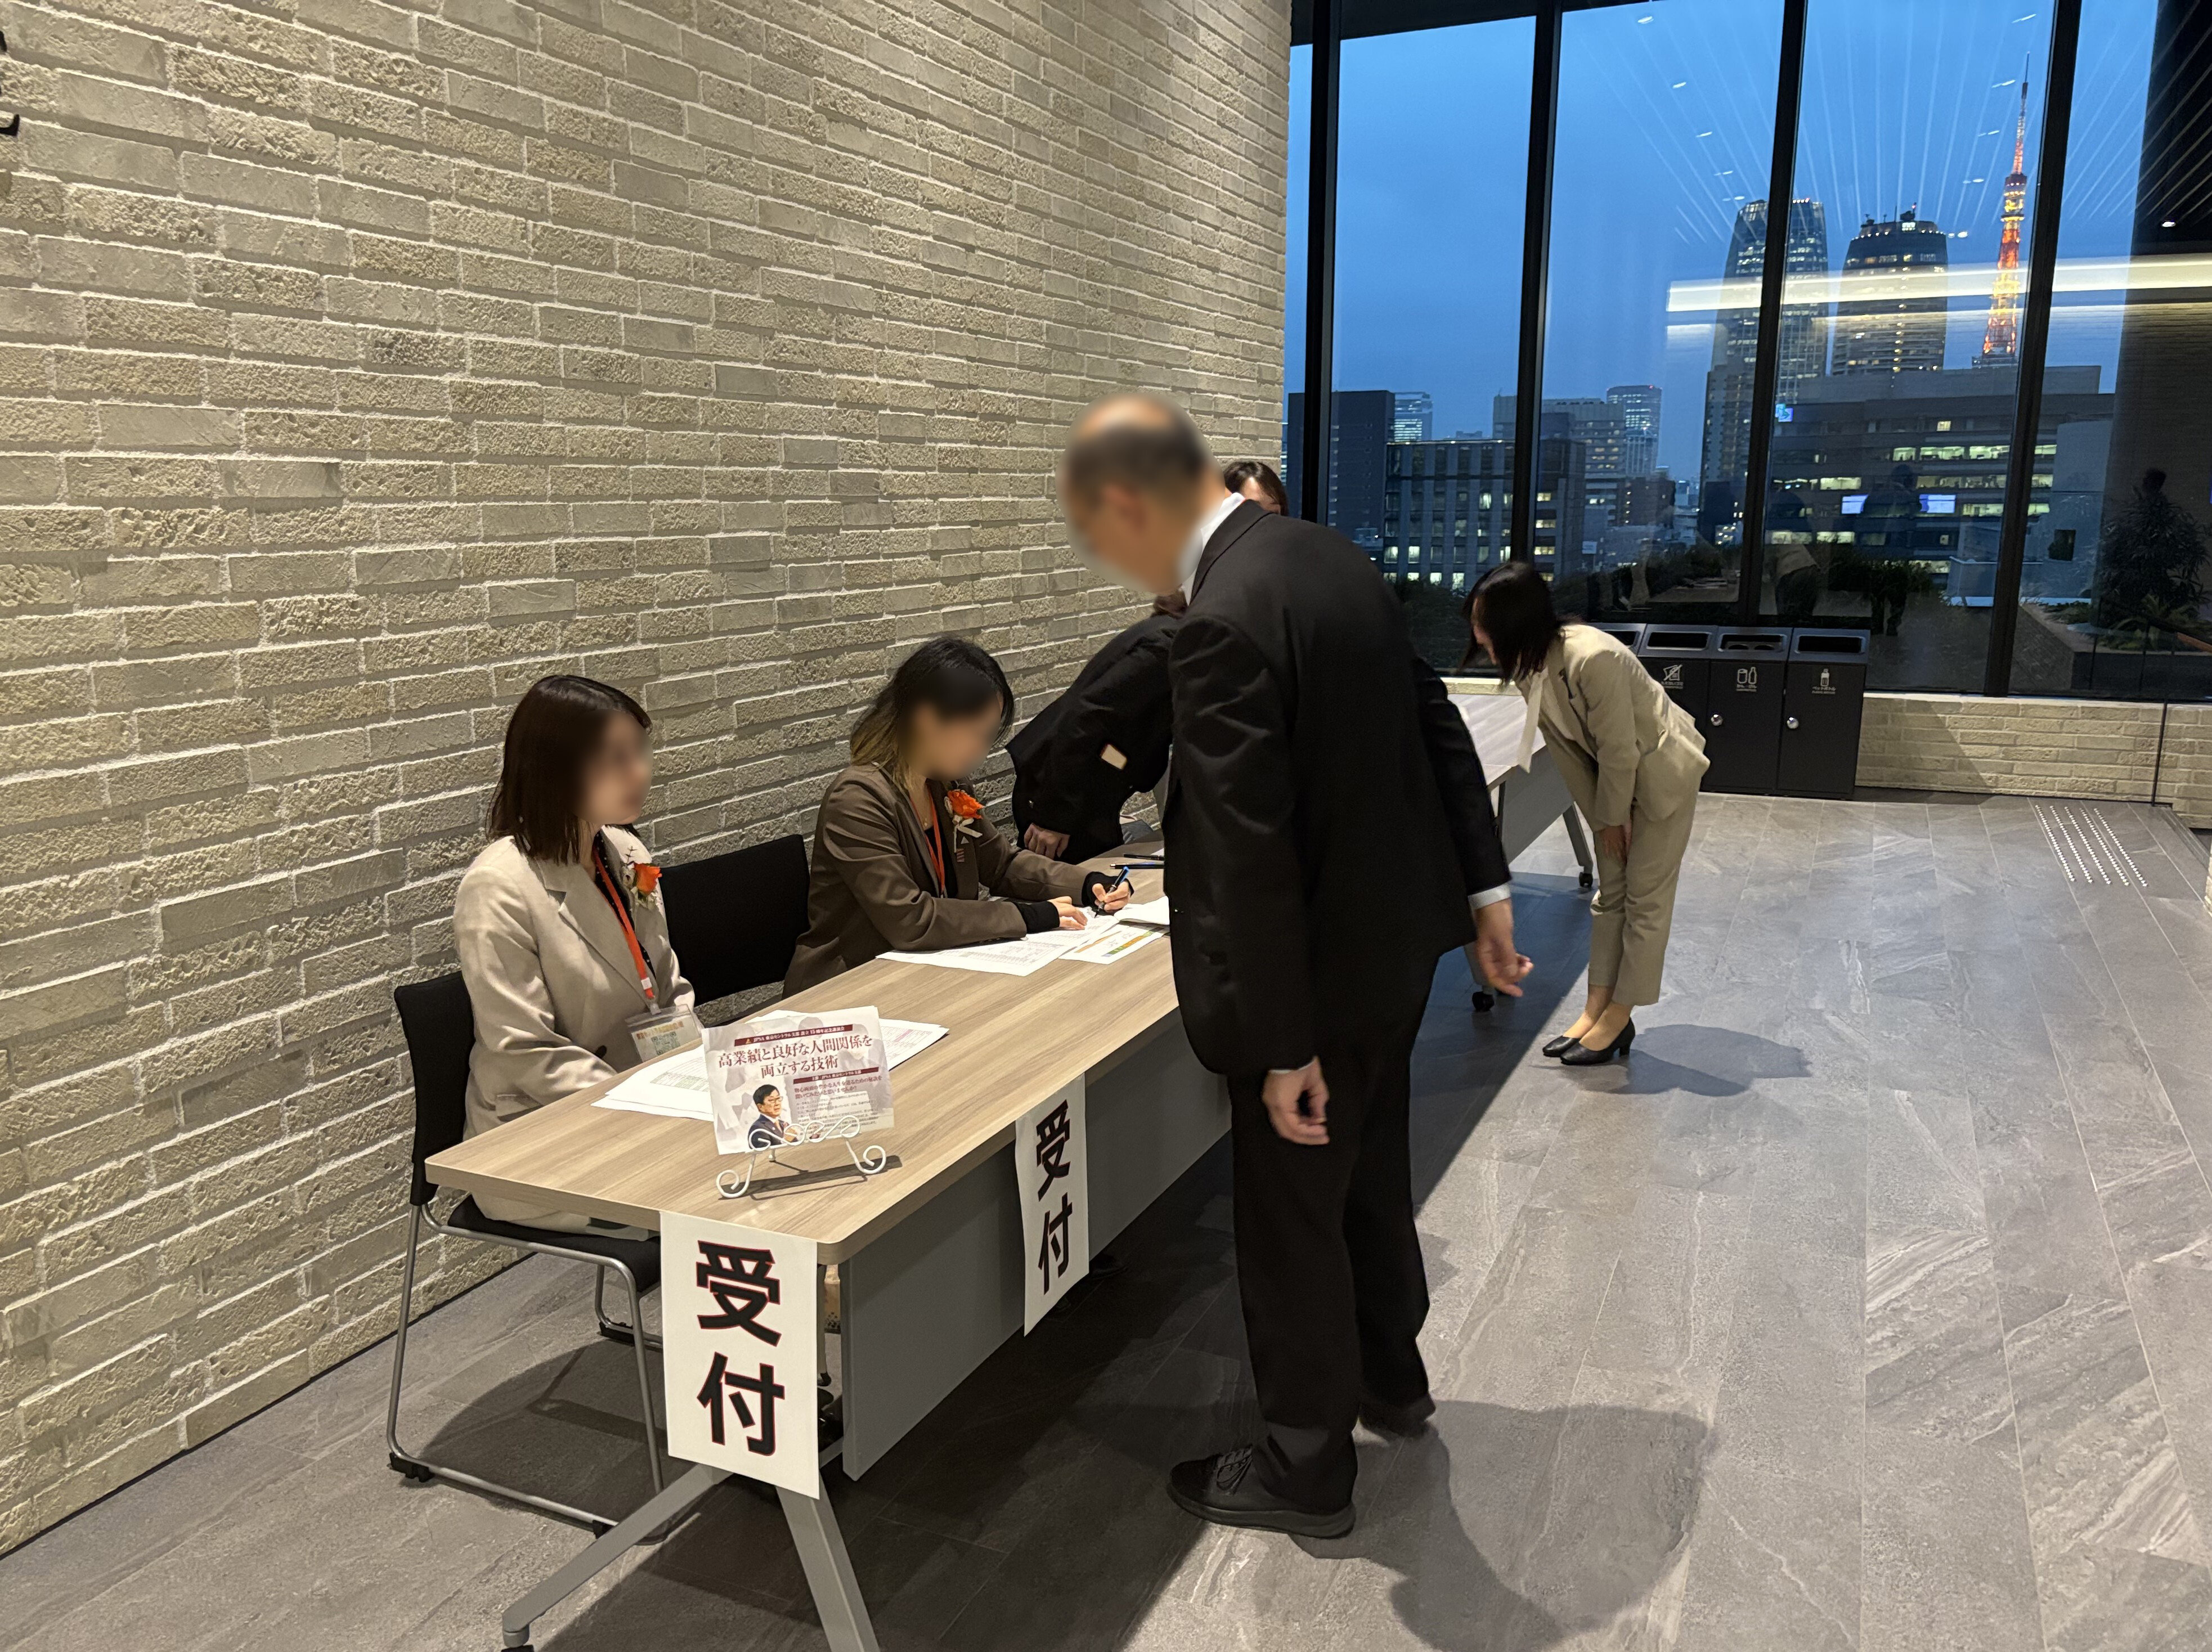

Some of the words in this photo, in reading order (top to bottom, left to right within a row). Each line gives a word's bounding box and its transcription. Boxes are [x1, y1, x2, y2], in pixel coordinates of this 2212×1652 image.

[718, 1035, 873, 1069] 高業績と良好な人間関係を
[761, 1054, 839, 1079] 両立する技術
[1038, 1099, 1073, 1295] 受付
[696, 1240, 784, 1457] 受付
